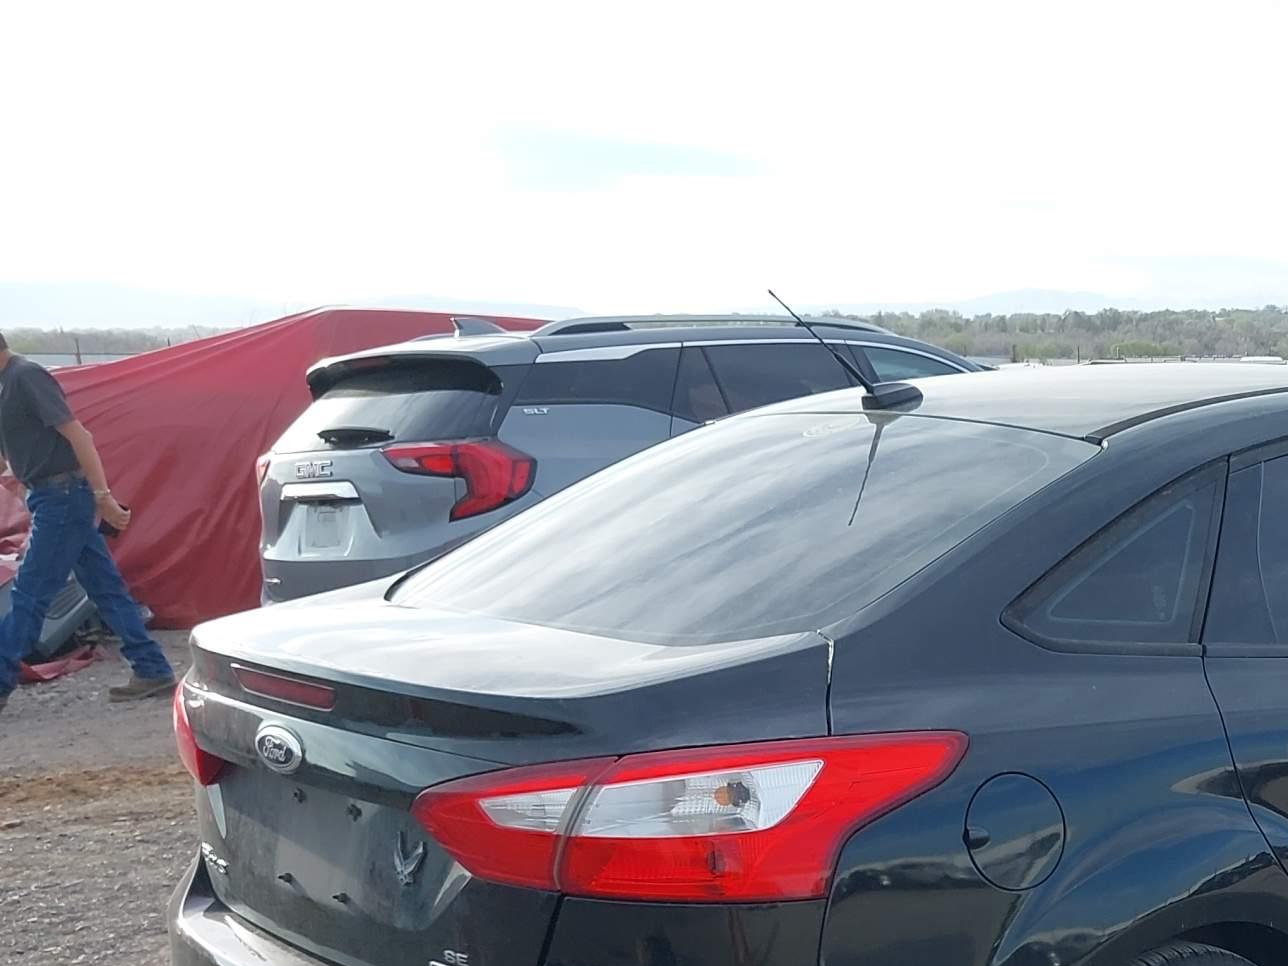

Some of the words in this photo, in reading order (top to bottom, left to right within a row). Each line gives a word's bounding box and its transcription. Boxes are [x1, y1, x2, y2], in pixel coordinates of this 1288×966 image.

[523, 407, 550, 415] SLT
[295, 460, 333, 478] GMC
[263, 736, 287, 762] Ford
[443, 950, 469, 966] SE
